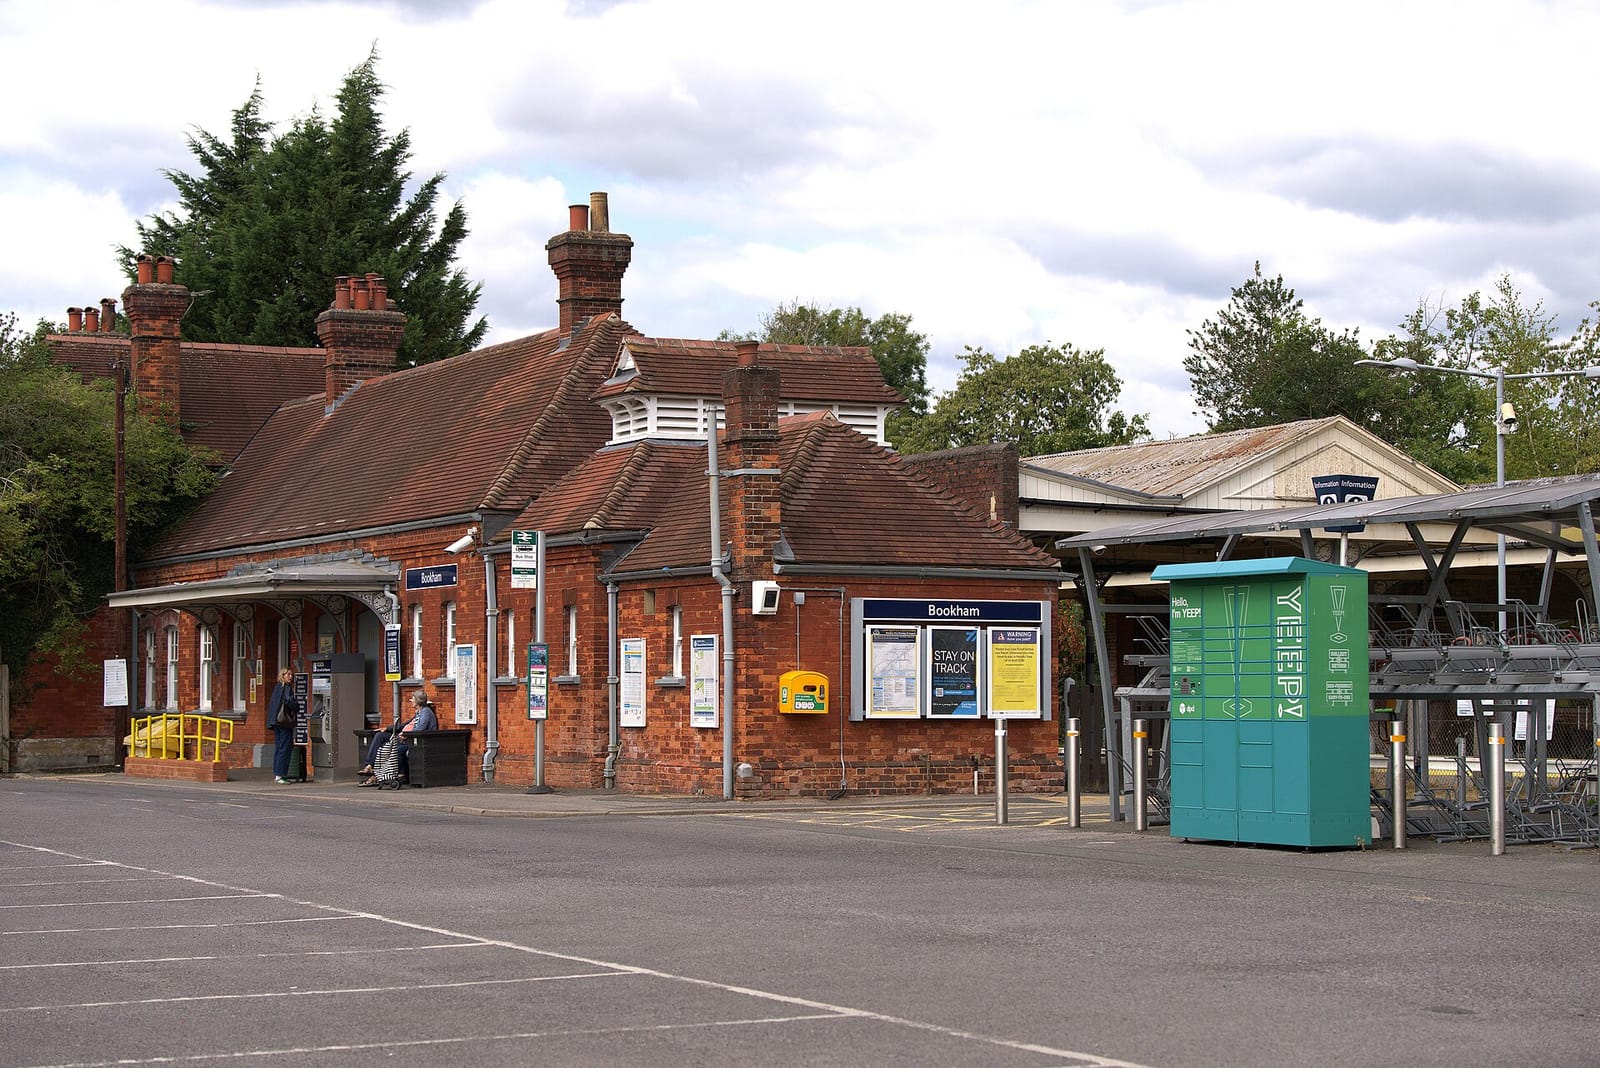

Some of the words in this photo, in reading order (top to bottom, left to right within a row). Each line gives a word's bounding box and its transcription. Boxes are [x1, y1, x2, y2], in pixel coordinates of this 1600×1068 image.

[1314, 480, 1339, 488] Information
[1341, 480, 1375, 489] Information
[421, 571, 442, 584] Bookham
[1172, 597, 1189, 608] Hello,
[928, 604, 980, 616] Bookham
[1182, 608, 1201, 618] YEEP!
[934, 650, 958, 661] STAY
[960, 650, 975, 661] ON
